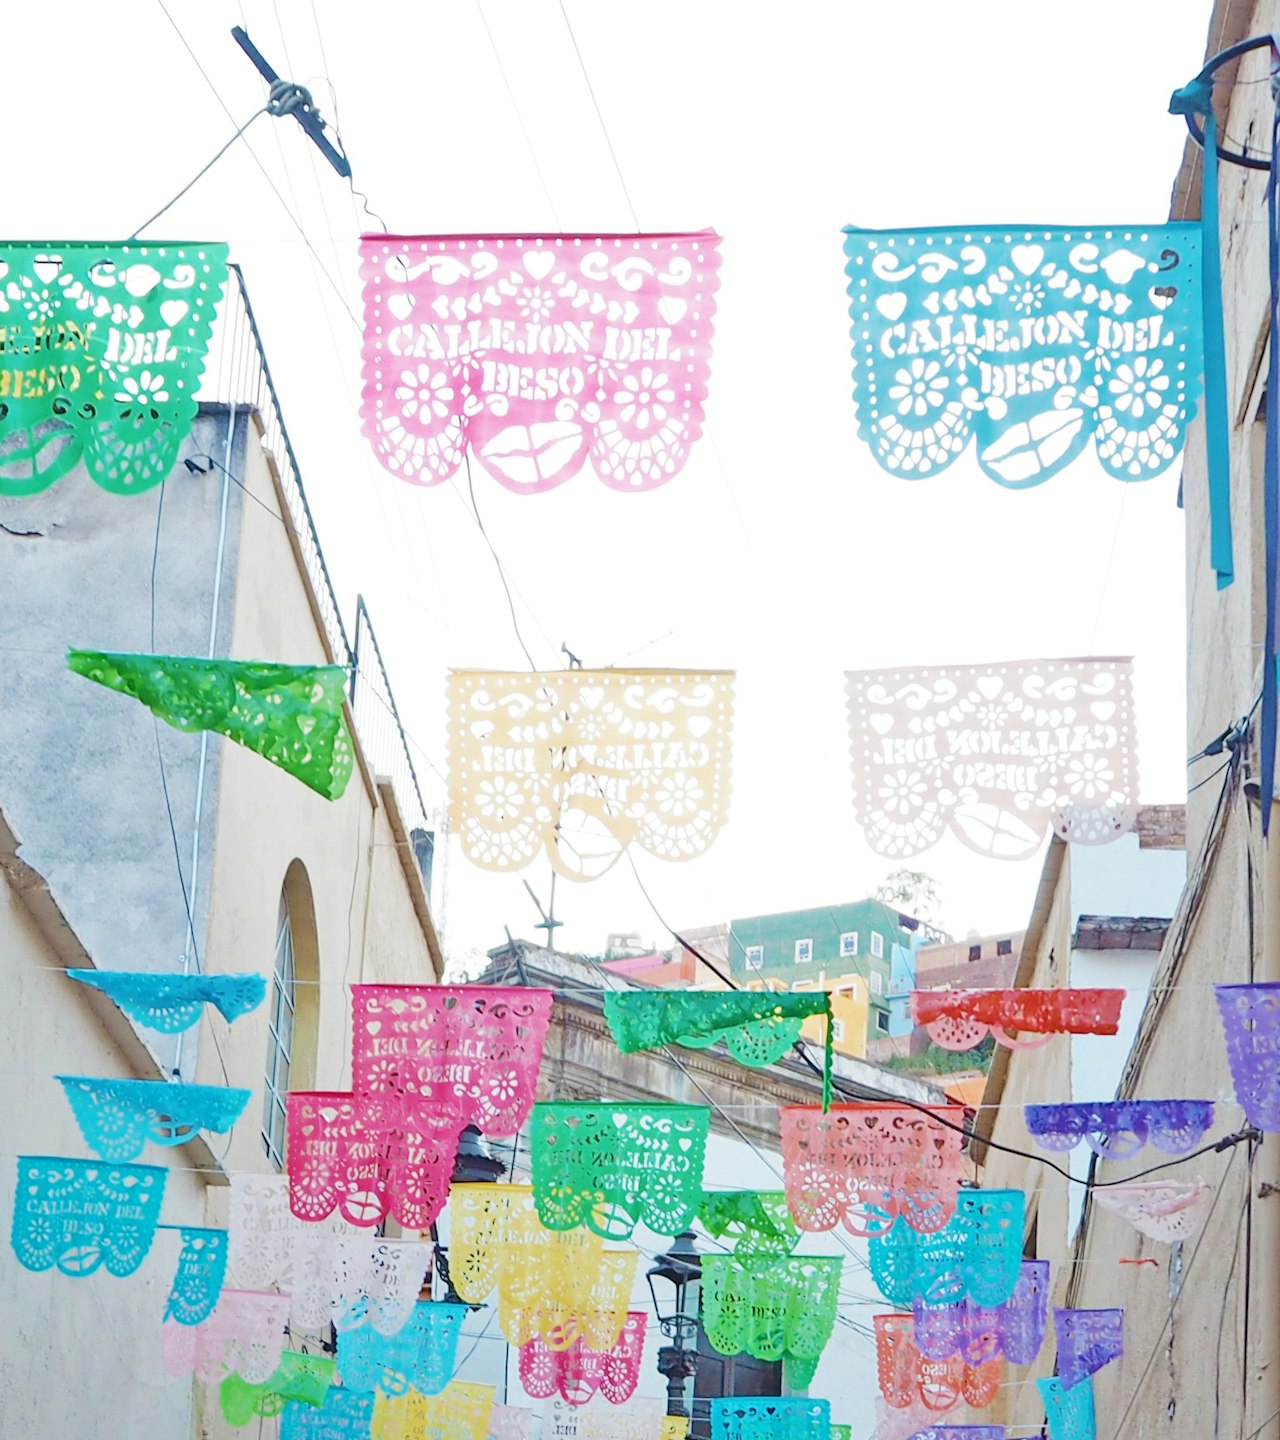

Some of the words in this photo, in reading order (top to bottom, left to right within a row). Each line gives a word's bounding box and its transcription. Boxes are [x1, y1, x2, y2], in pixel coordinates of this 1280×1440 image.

[104, 326, 178, 366] DEL
[387, 316, 595, 359] CALLEJON
[604, 325, 682, 361] DEL
[879, 309, 1089, 359] CALLEJON
[1097, 314, 1175, 353] DEL
[482, 360, 586, 400] BESO
[979, 355, 1082, 399] BESO
[26, 1199, 111, 1218] CALLEJON
[115, 1204, 145, 1220] DEL
[62, 1218, 105, 1235] BESO
